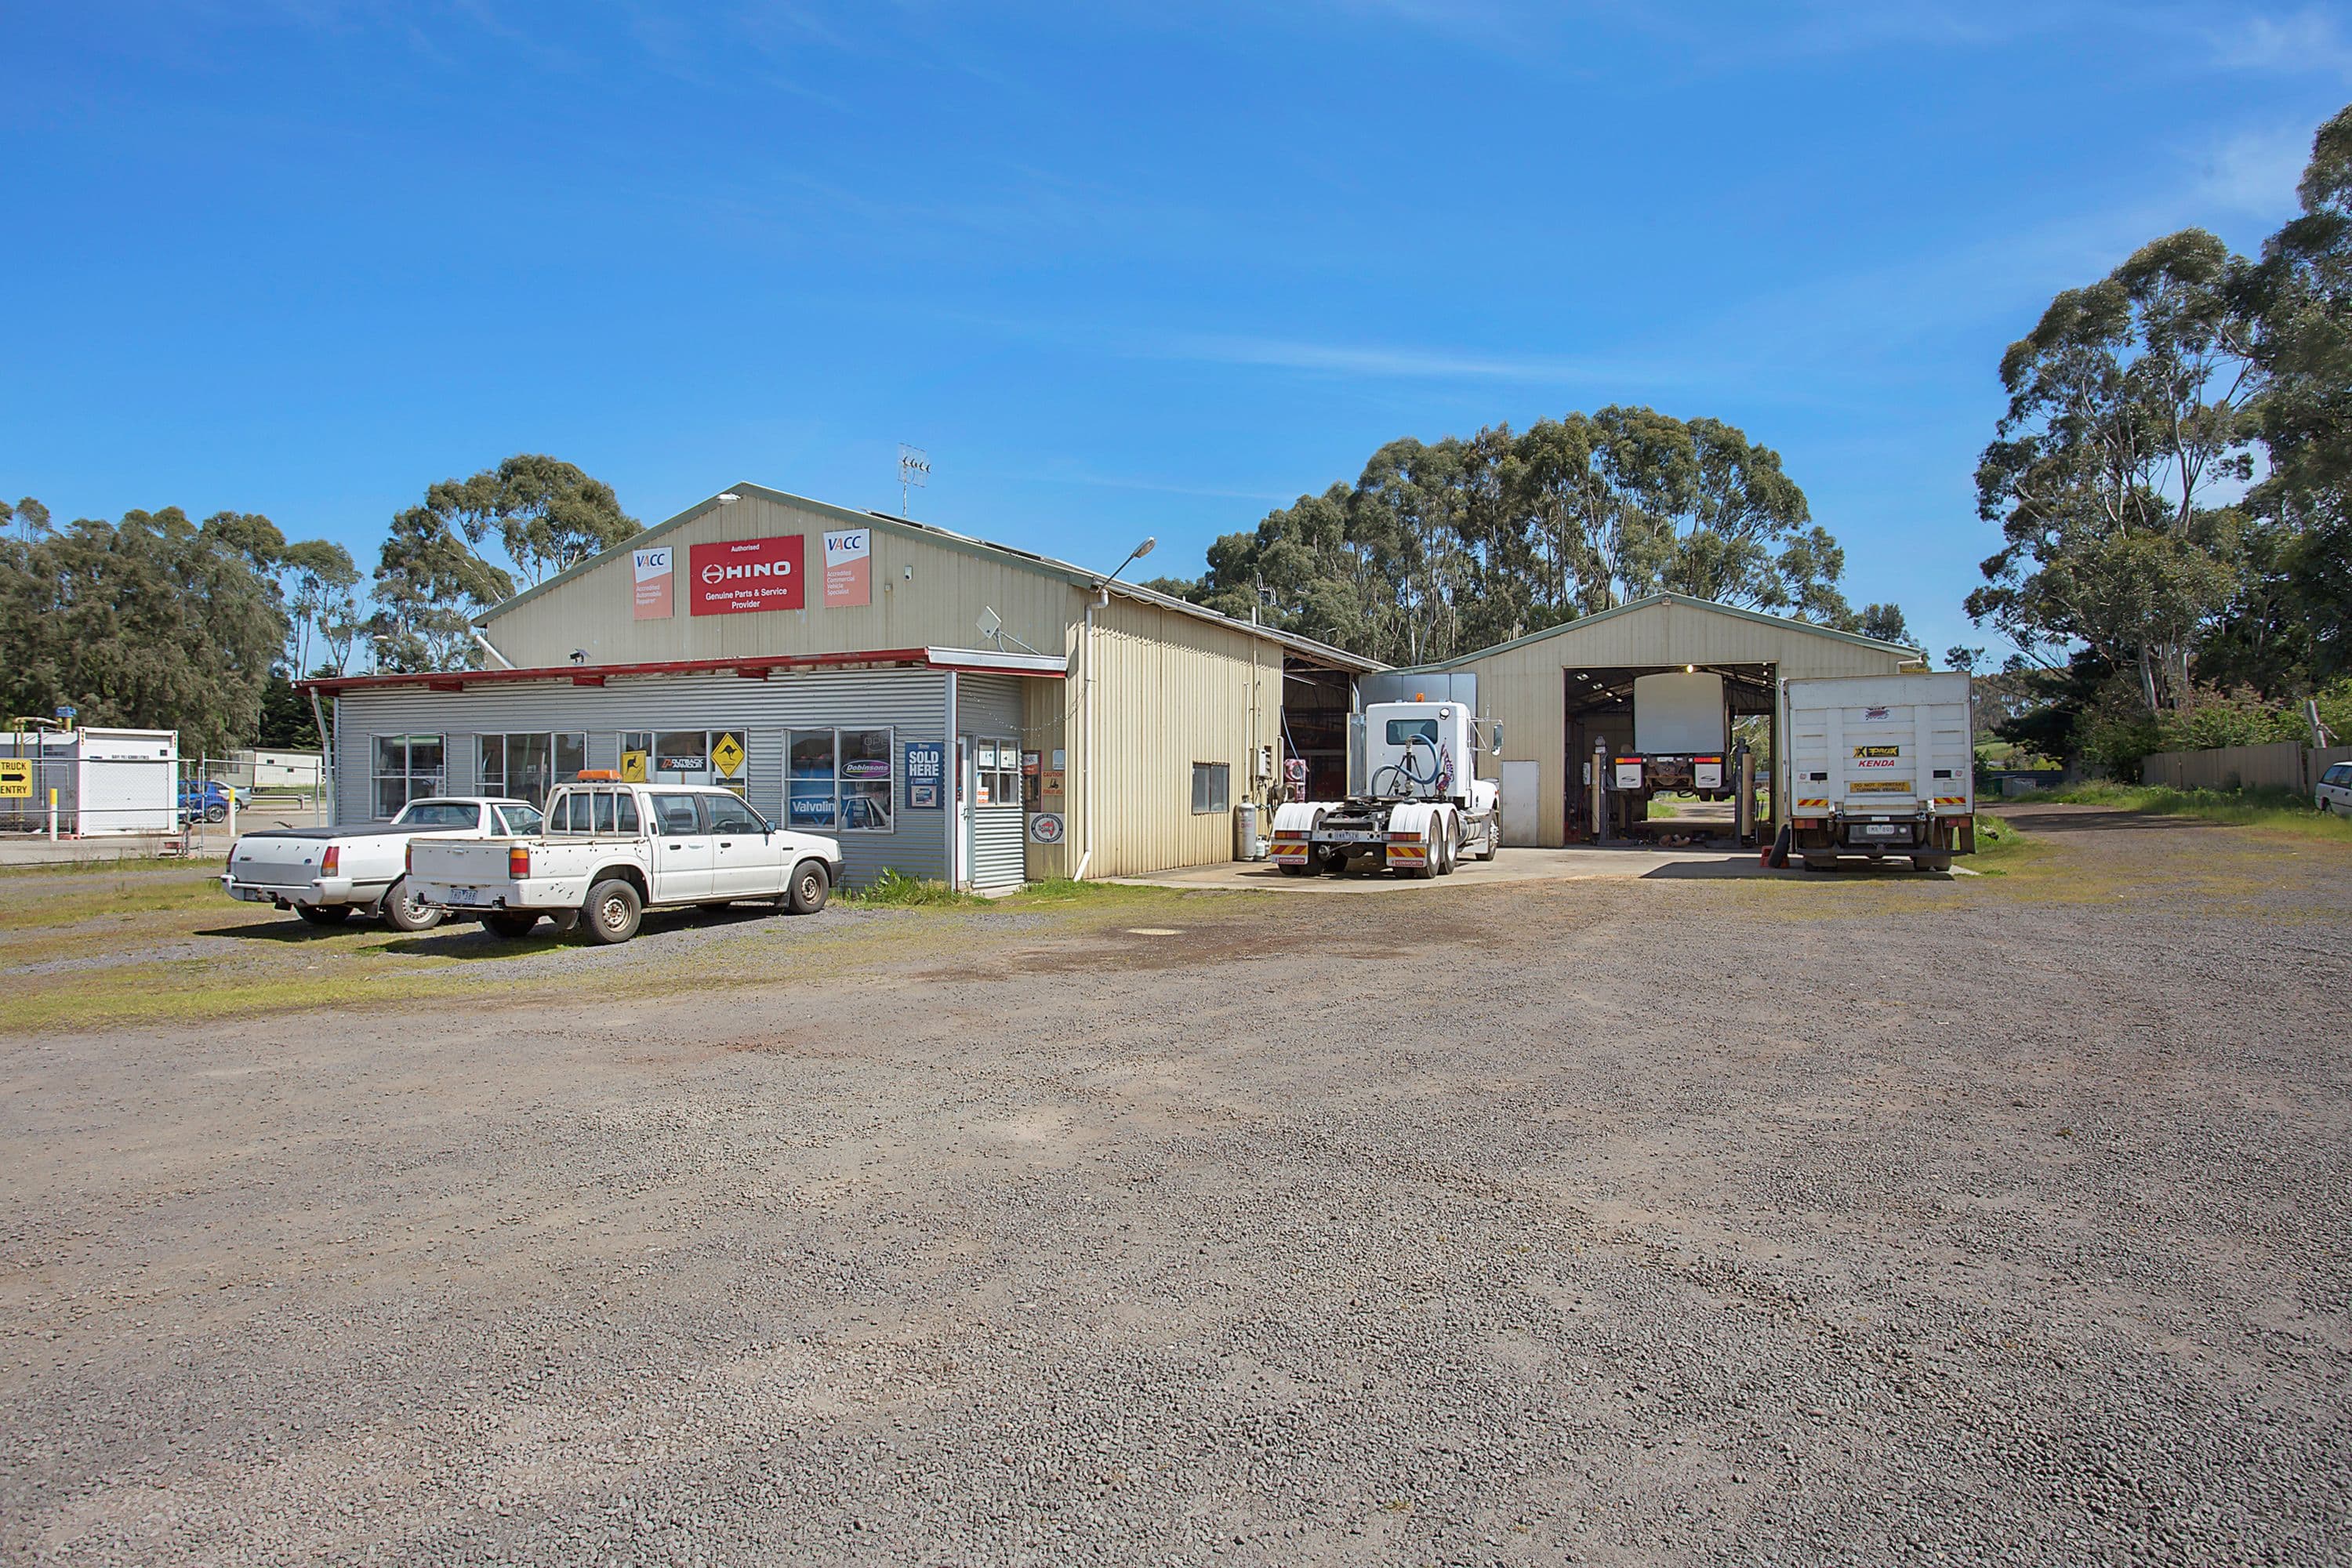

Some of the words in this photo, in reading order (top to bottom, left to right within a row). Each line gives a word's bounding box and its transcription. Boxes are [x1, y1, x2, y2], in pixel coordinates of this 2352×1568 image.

[828, 535, 861, 550] VACC
[637, 554, 665, 567] VACC
[726, 561, 791, 579] HINO
[706, 591, 733, 601] Genuine
[735, 590, 753, 598] Parts
[761, 587, 787, 597] Service
[731, 600, 760, 608] Provider
[909, 751, 938, 764] SOLD
[2, 761, 27, 770] TRUCK
[909, 764, 939, 776] HERE
[792, 800, 835, 812] Valvolin
